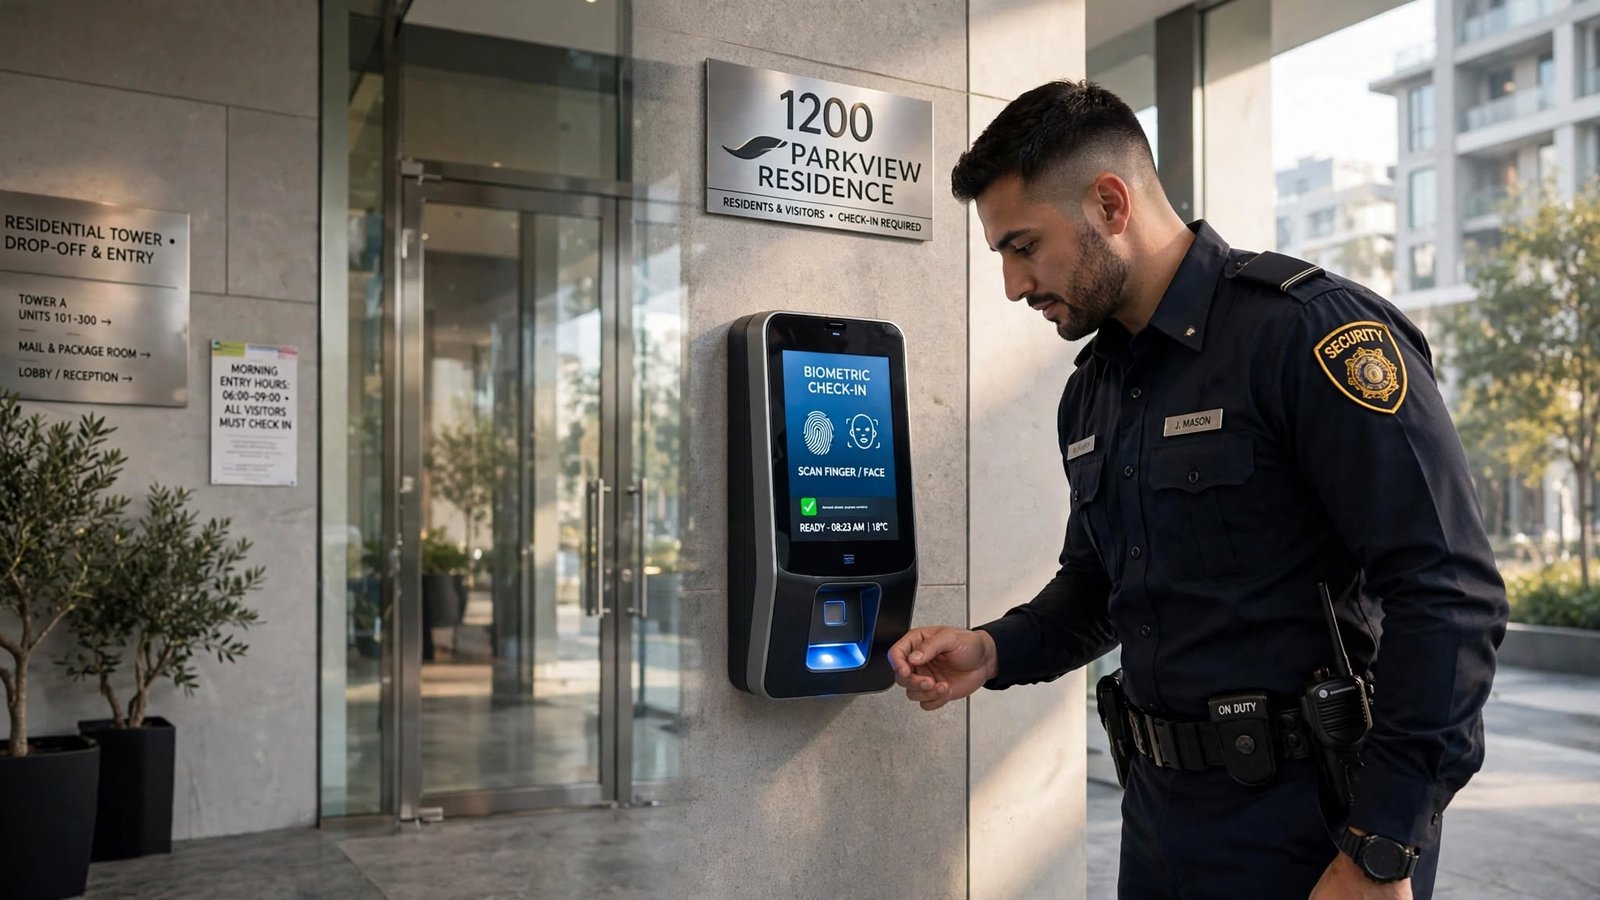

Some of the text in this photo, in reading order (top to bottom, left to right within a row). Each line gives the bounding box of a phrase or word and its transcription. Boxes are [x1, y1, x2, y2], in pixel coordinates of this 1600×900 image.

[780, 89, 874, 142] 1200
[791, 142, 922, 183] PARKVIEW
[759, 165, 894, 205] RESIDENCE
[723, 196, 922, 232] RESIDENTS & VISITORS CHECK-IN REQUIRED
[5, 214, 162, 246] RESIDENTIAL TOWER
[5, 235, 155, 264] DROP-OFF & ENTRY
[18, 294, 67, 308] TOWER A
[18, 309, 97, 325] UNITS 101-300
[18, 341, 137, 358] MAIL & PACKAGE ROOM
[1324, 328, 1384, 359] SECURITY
[18, 367, 52, 378] LOBBY
[63, 370, 118, 382] RECEPTION
[231, 363, 278, 376] MORNING
[803, 365, 871, 381] BIOMETRIC
[220, 376, 290, 390] ENTRY HOURS:
[808, 382, 867, 396] CHECK-IN
[224, 404, 287, 417] ALL VISITORS
[219, 417, 292, 430] MUST CHECK IN
[1175, 416, 1212, 430] J. MASON
[798, 466, 822, 476] SCAN
[824, 467, 856, 477] FINGER
[863, 467, 885, 477] FACE
[800, 522, 825, 533] READY
[831, 522, 852, 532] 08:23
[852, 522, 865, 532] AM
[872, 522, 889, 531] 18°C
[1218, 701, 1257, 715] ON DUTY
